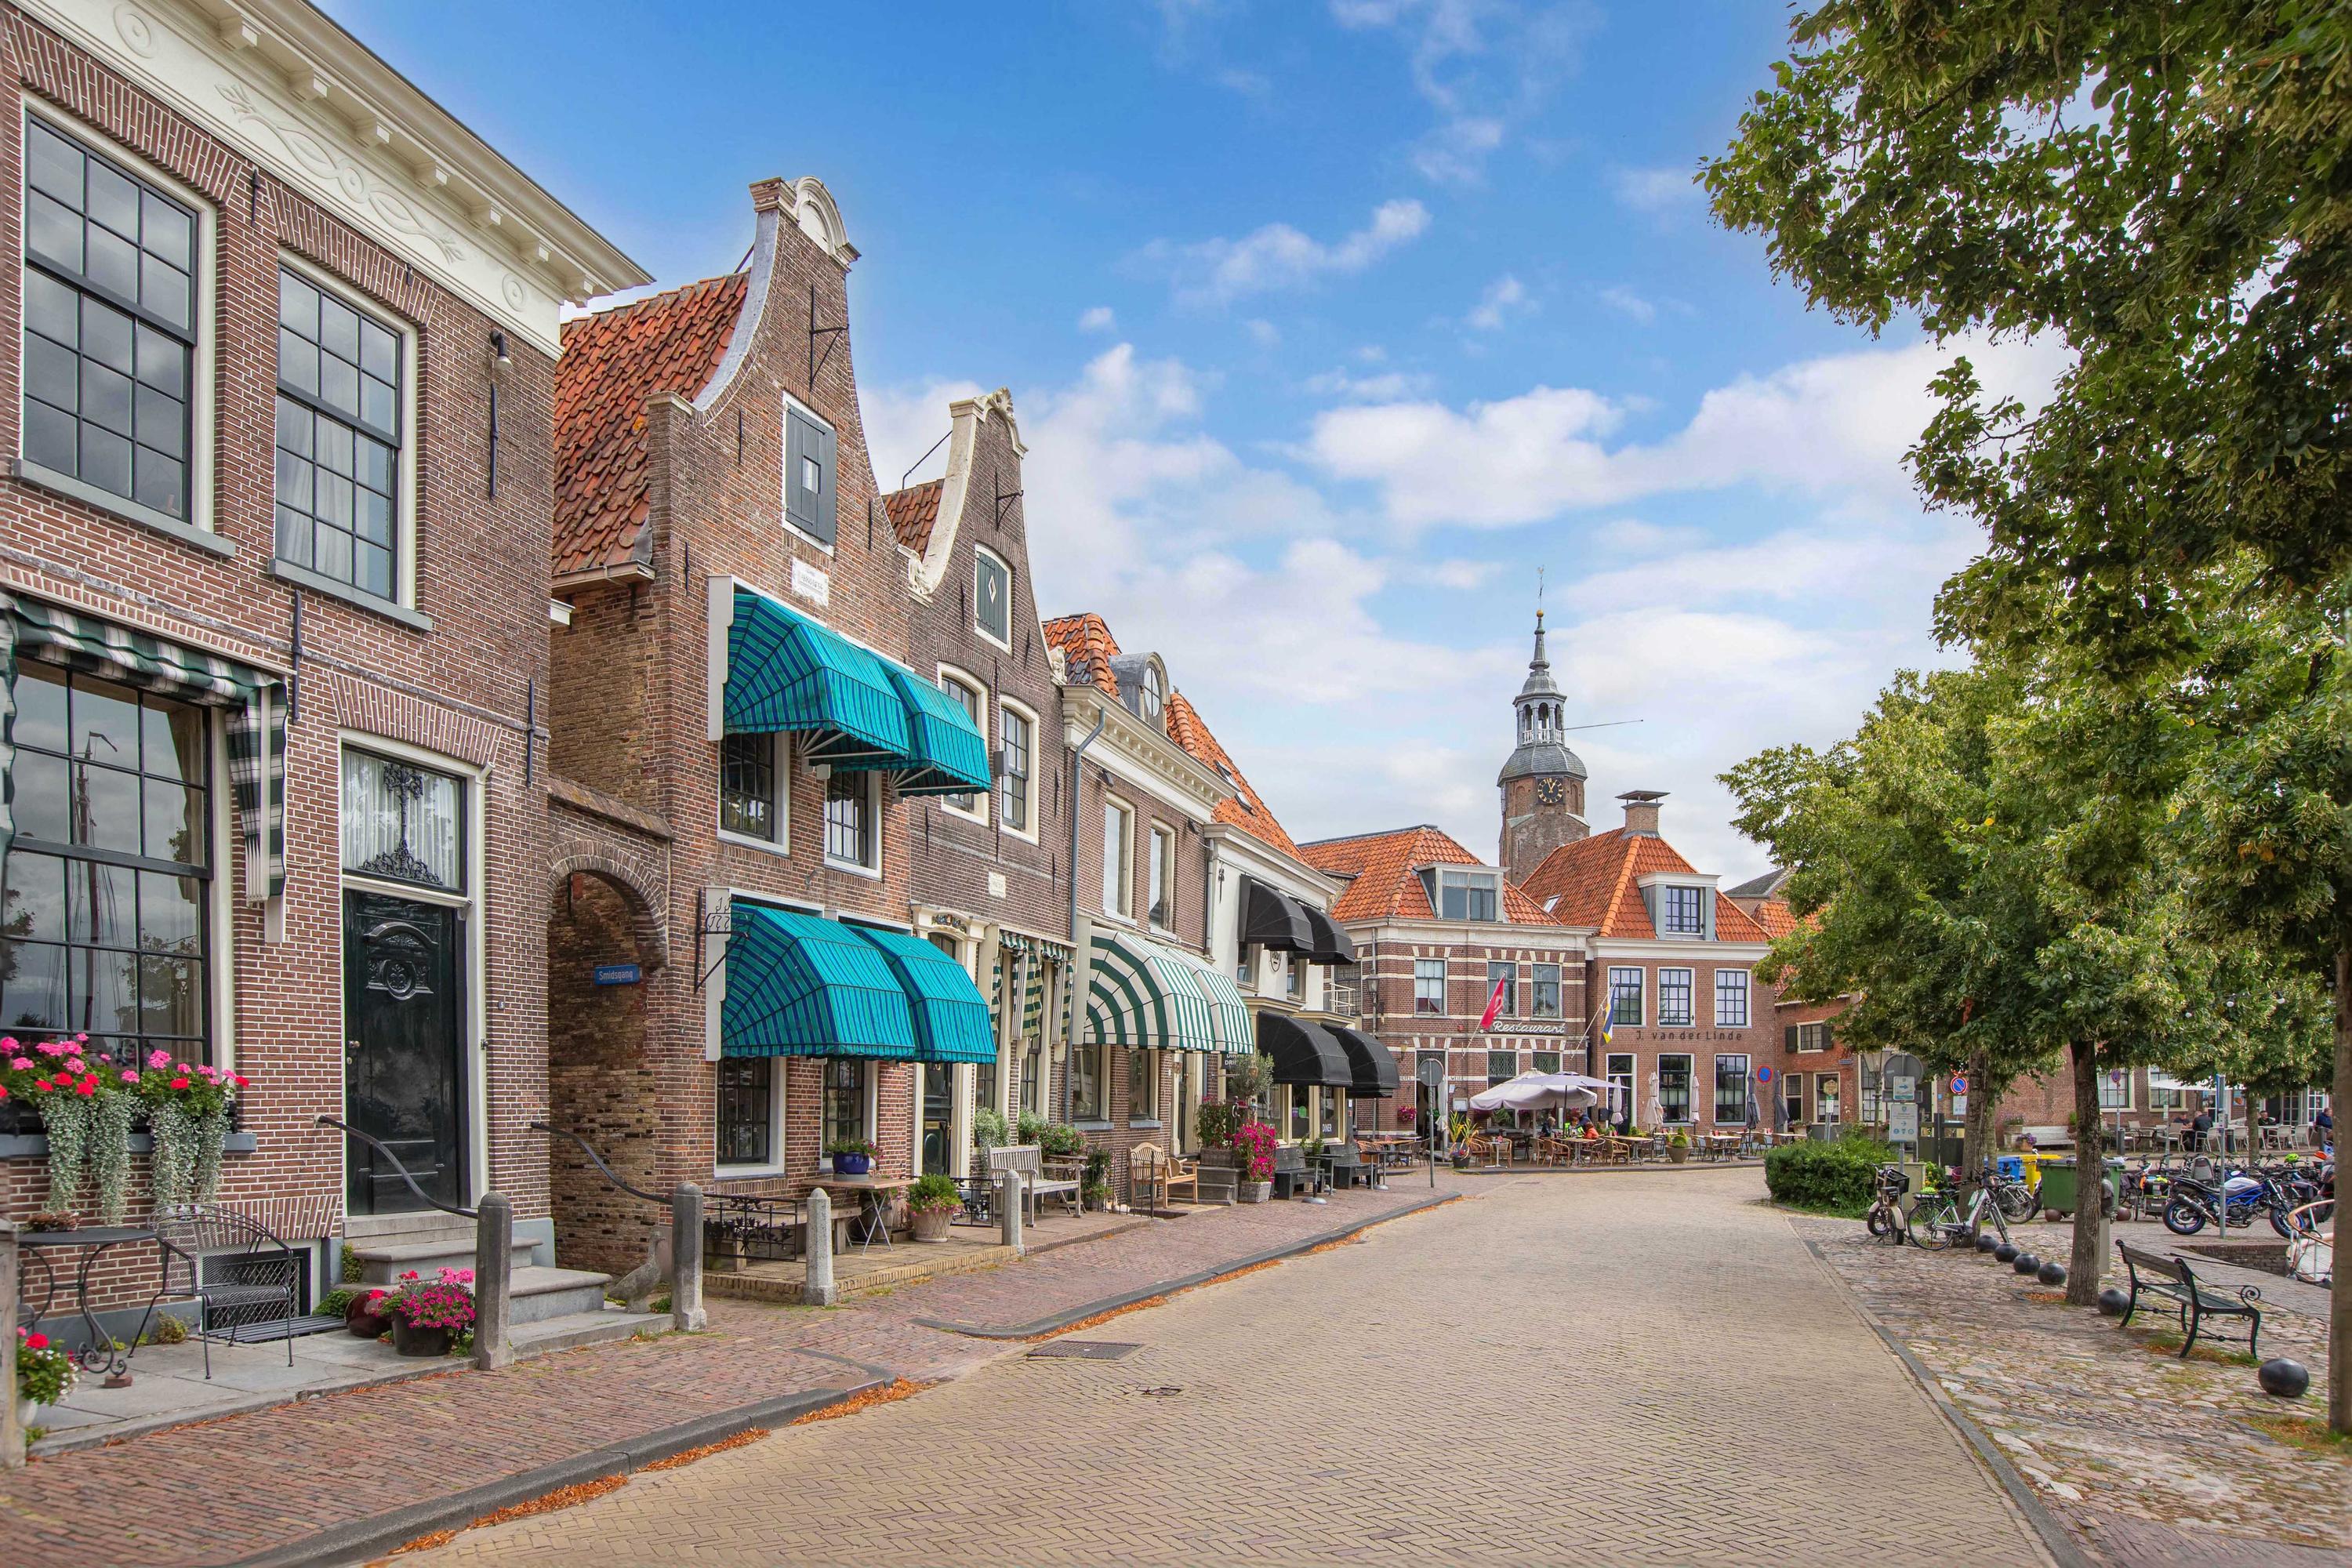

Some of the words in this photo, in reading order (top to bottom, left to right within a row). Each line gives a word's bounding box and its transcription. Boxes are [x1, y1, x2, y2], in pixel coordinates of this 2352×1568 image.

[598, 970, 633, 982] Smidsgang
[1492, 1021, 1566, 1034] Restaurant
[1652, 1031, 1675, 1040] van
[1679, 1030, 1700, 1040] der
[1706, 1030, 1742, 1040] Linde
[1322, 1123, 1332, 1133] DINER
